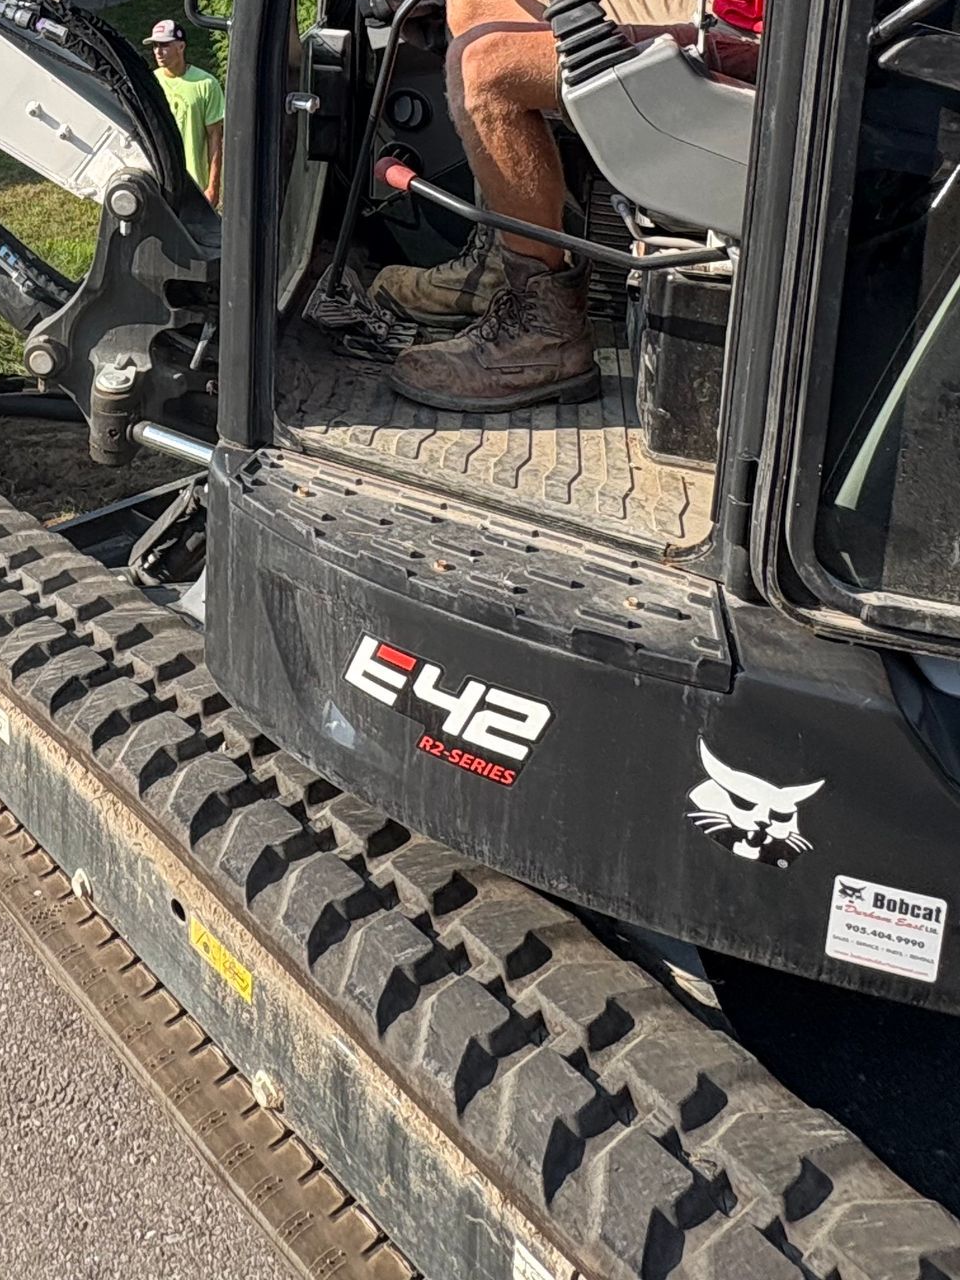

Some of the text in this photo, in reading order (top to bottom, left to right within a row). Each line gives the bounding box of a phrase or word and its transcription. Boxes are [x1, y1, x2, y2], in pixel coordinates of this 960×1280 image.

[344, 635, 551, 761] E42
[418, 735, 517, 786] R2-SERIES
[872, 892, 942, 924] Bobcat
[845, 922, 926, 949] 905.404.9990
